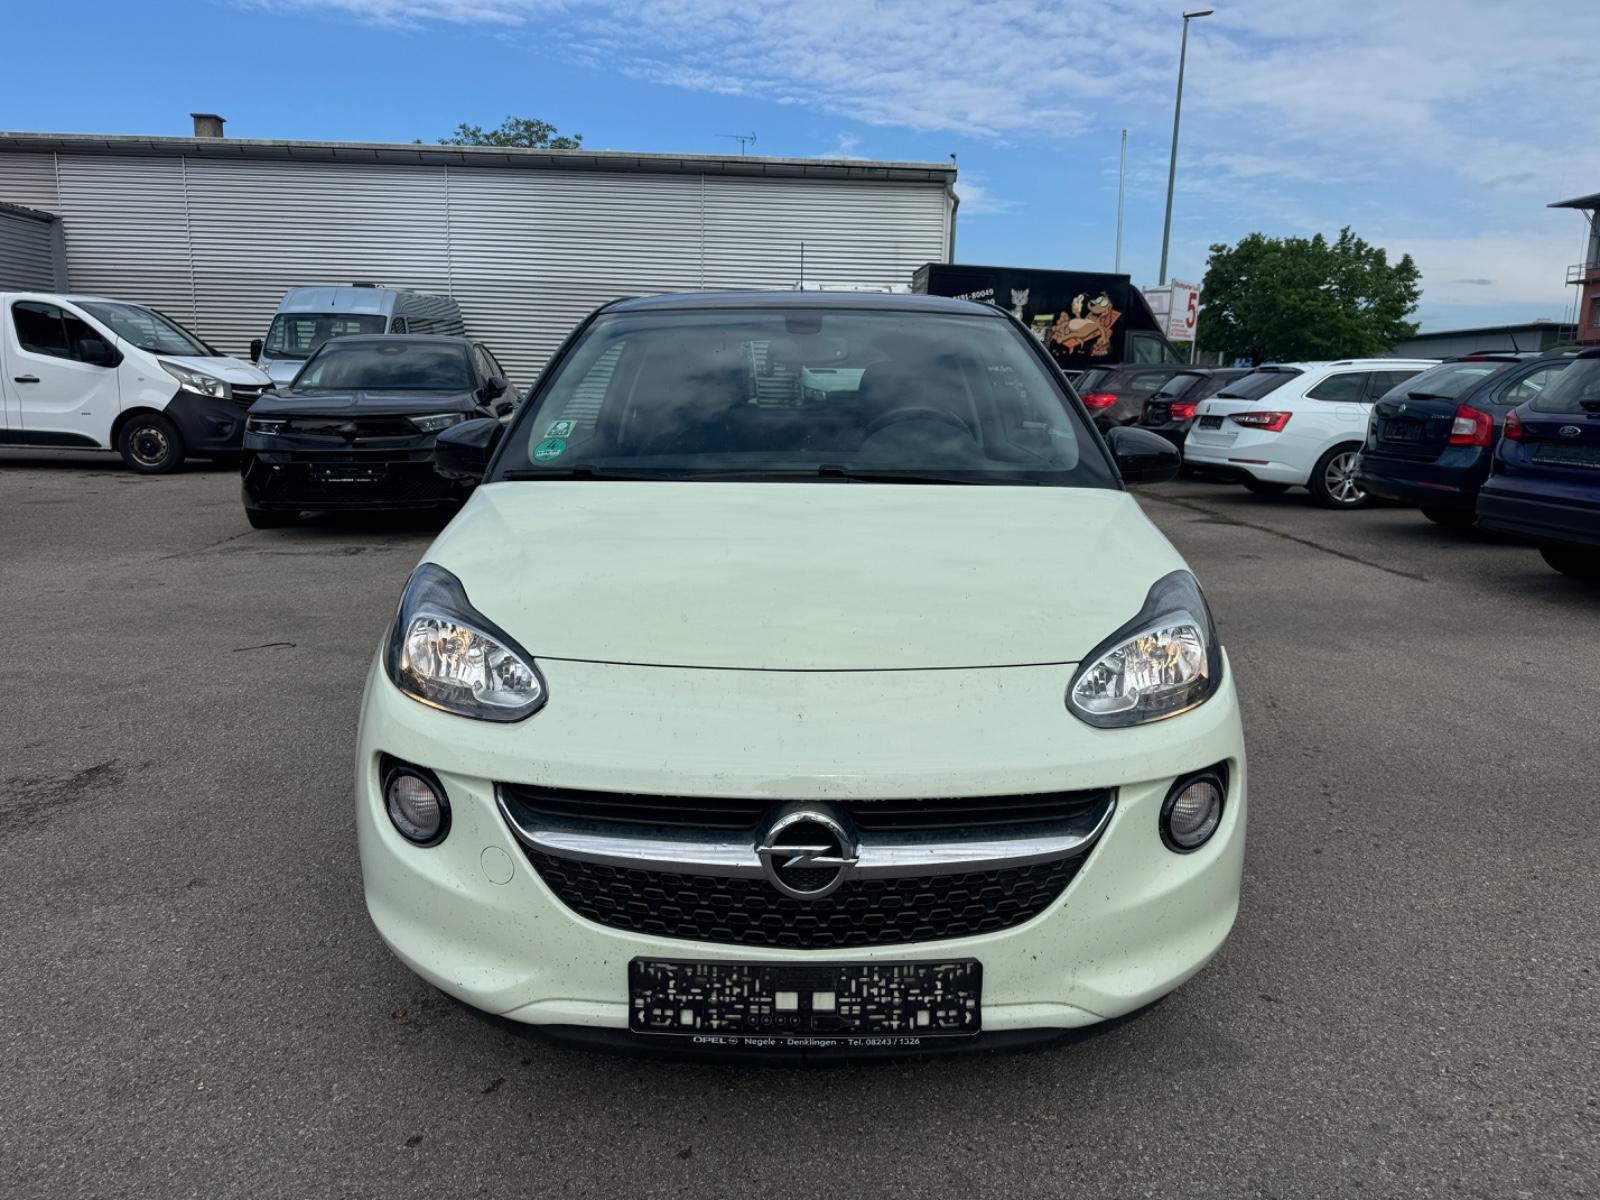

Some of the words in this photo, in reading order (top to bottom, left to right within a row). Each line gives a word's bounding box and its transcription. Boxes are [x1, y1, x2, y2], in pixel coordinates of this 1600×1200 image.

[1186, 292, 1198, 328] 5
[693, 1036, 727, 1044] OPEL
[744, 1037, 776, 1047] Negele
[787, 1037, 837, 1047] Denklingen
[847, 1037, 864, 1046] Tel.
[865, 1037, 892, 1046] 08243
[899, 1036, 921, 1046] 1326
